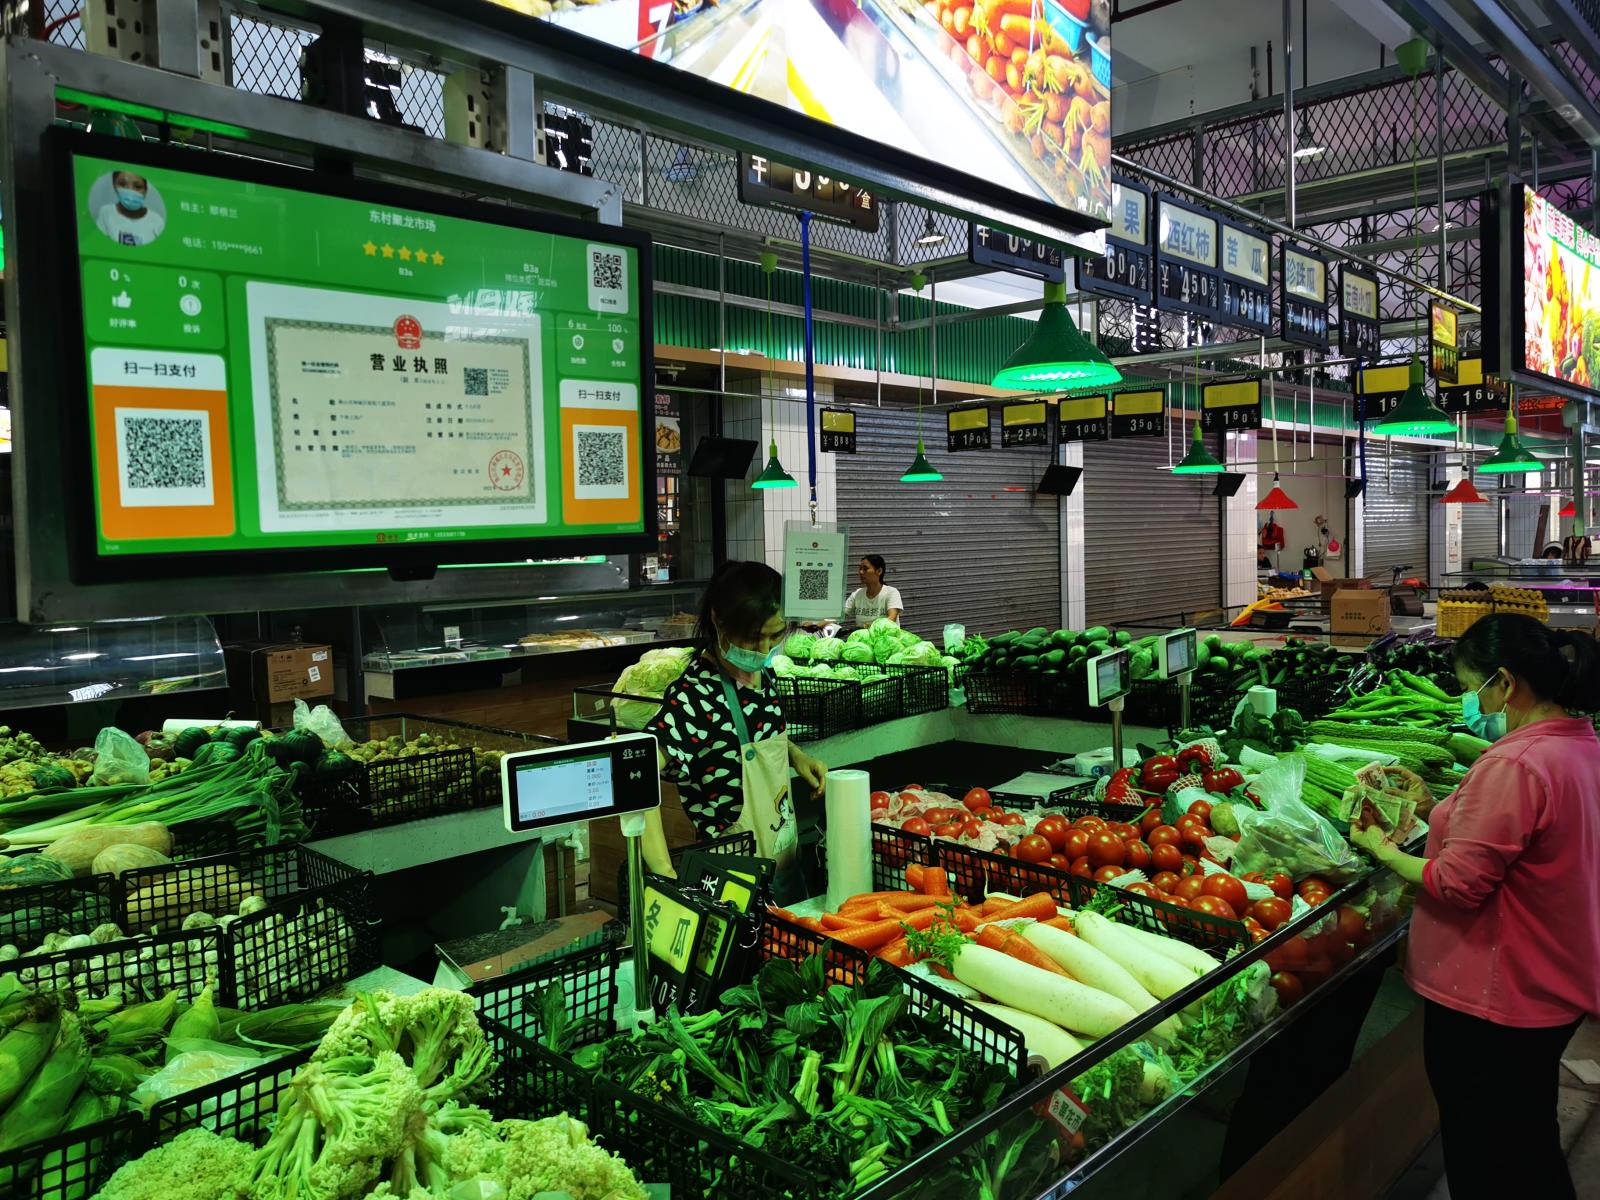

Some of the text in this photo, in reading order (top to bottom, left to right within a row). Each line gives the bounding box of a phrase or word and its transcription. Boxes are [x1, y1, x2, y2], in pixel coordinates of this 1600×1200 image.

[1166, 219, 1210, 262] 西红柿
[1227, 235, 1263, 276] 苦瓜
[1160, 264, 1169, 296] ¥
[123, 360, 197, 378] 扫一扫支付
[369, 353, 448, 375] 营业执照
[578, 389, 621, 401] 扫一扫支付
